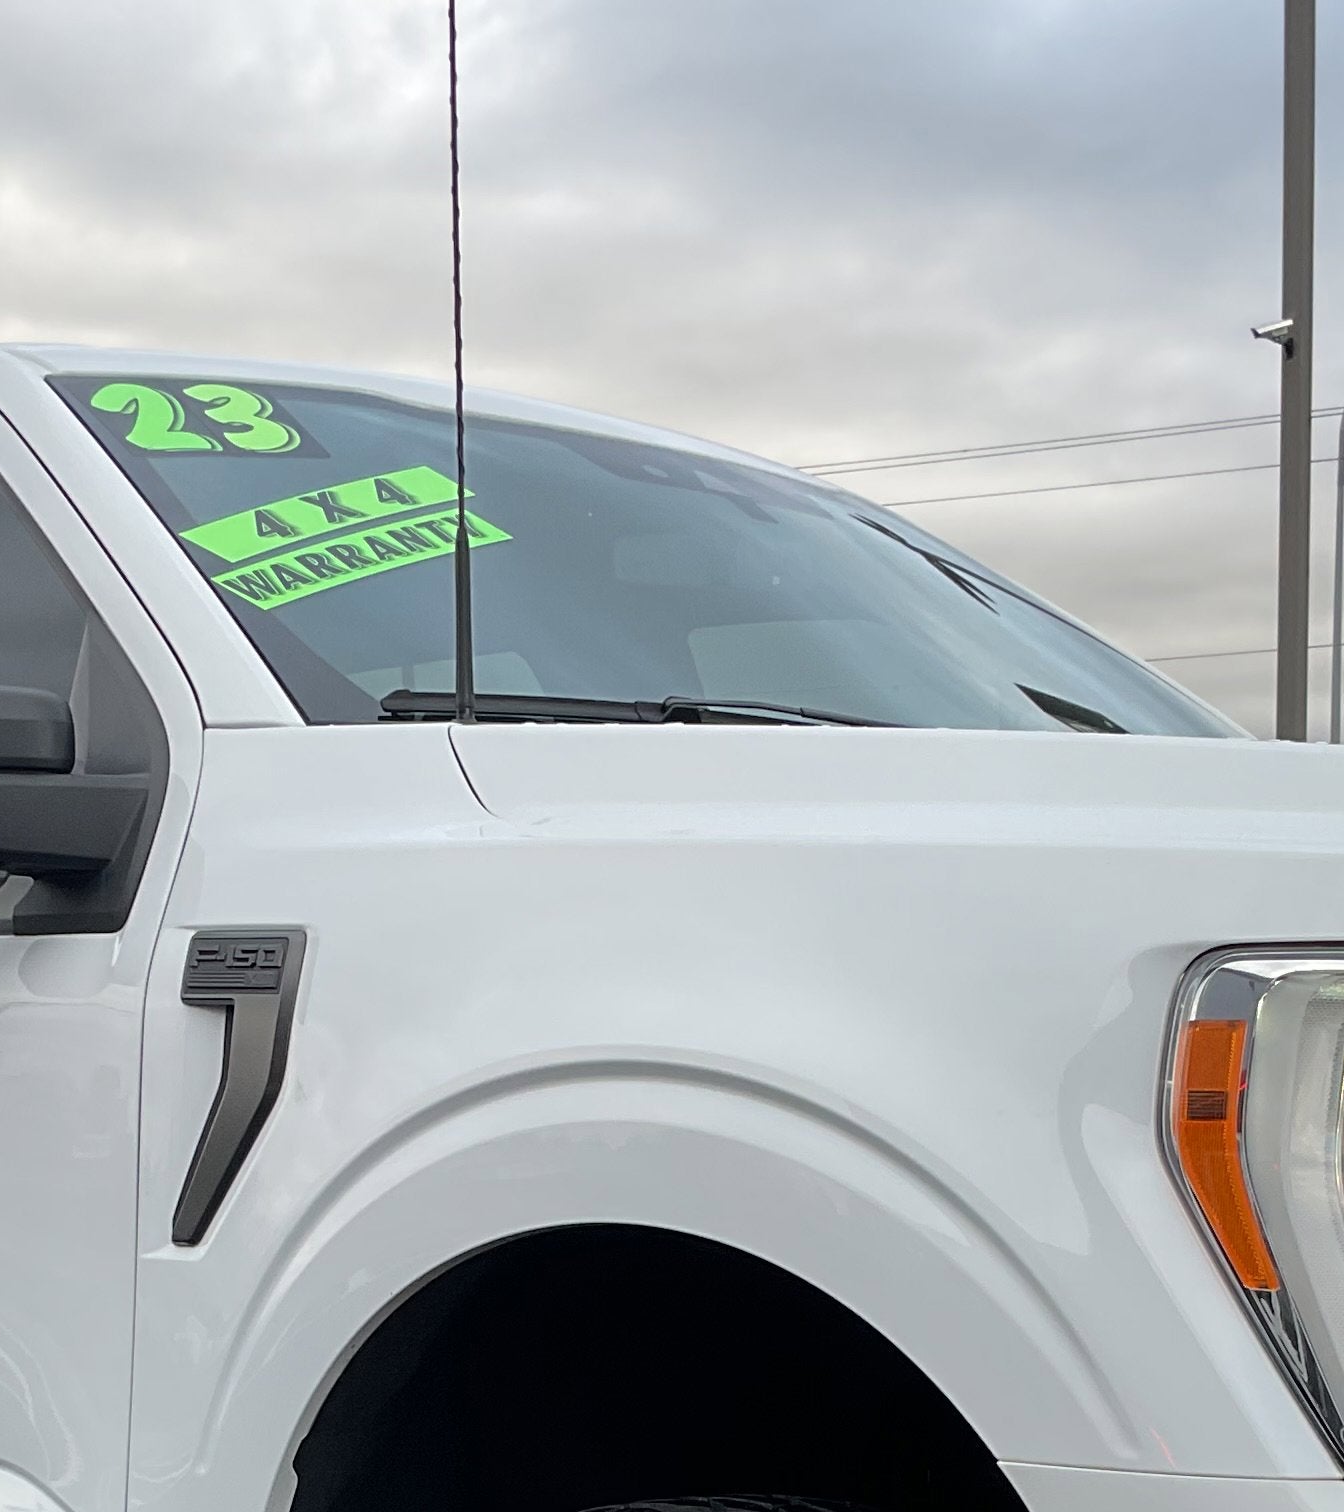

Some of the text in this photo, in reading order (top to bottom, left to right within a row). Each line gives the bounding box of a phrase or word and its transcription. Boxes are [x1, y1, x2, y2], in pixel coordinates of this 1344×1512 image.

[90, 383, 302, 453] 23
[255, 509, 299, 539] 4
[373, 477, 420, 506] 4
[221, 513, 489, 601] WARRANTY
[189, 944, 284, 968] F-150
